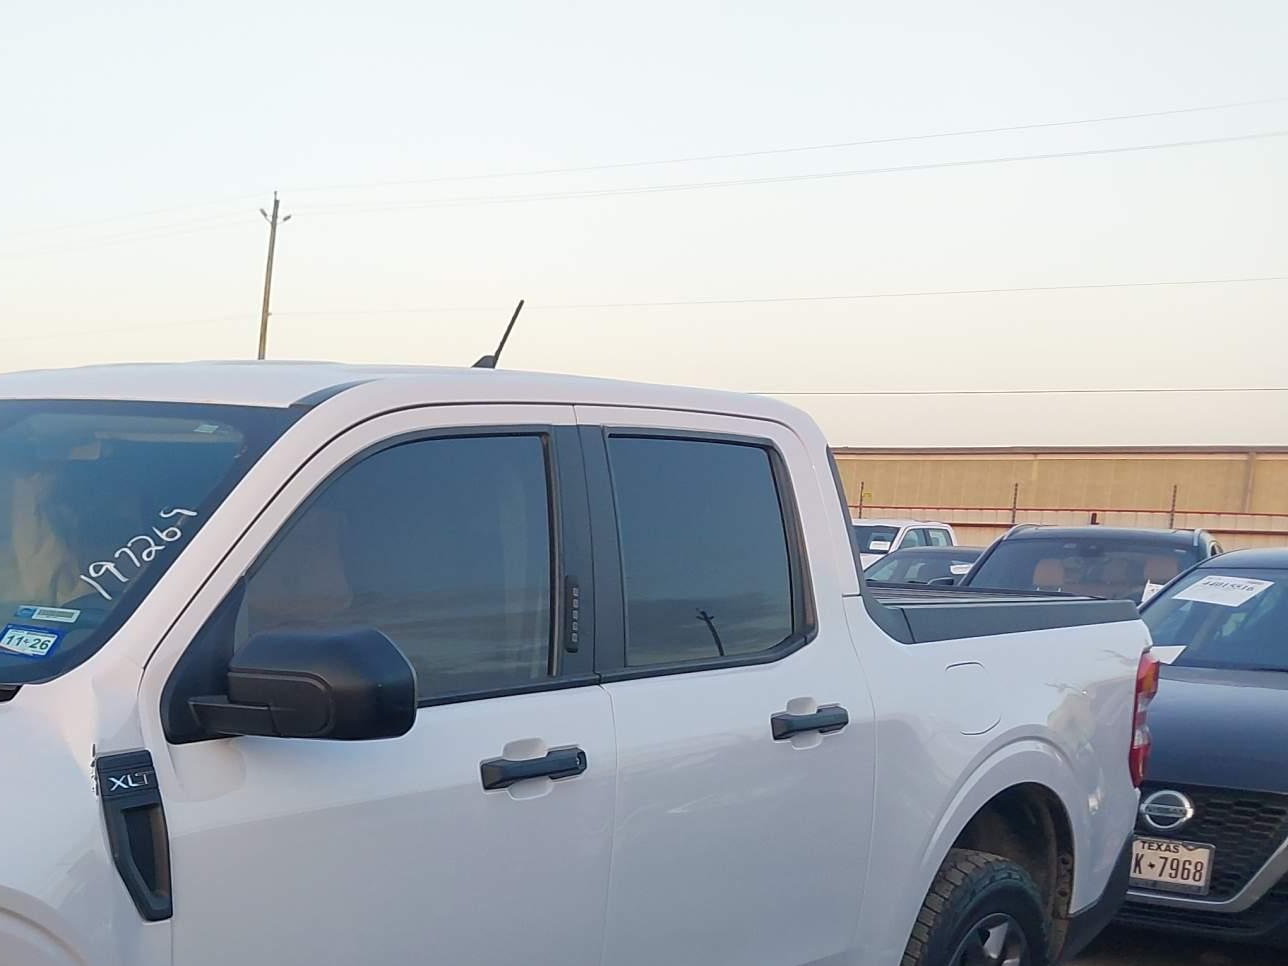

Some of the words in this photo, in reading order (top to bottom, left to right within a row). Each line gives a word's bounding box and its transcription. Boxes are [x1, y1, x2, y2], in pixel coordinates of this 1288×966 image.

[28, 638, 52, 651] 26
[108, 771, 152, 791] XLT
[1140, 841, 1180, 854] TEXAS
